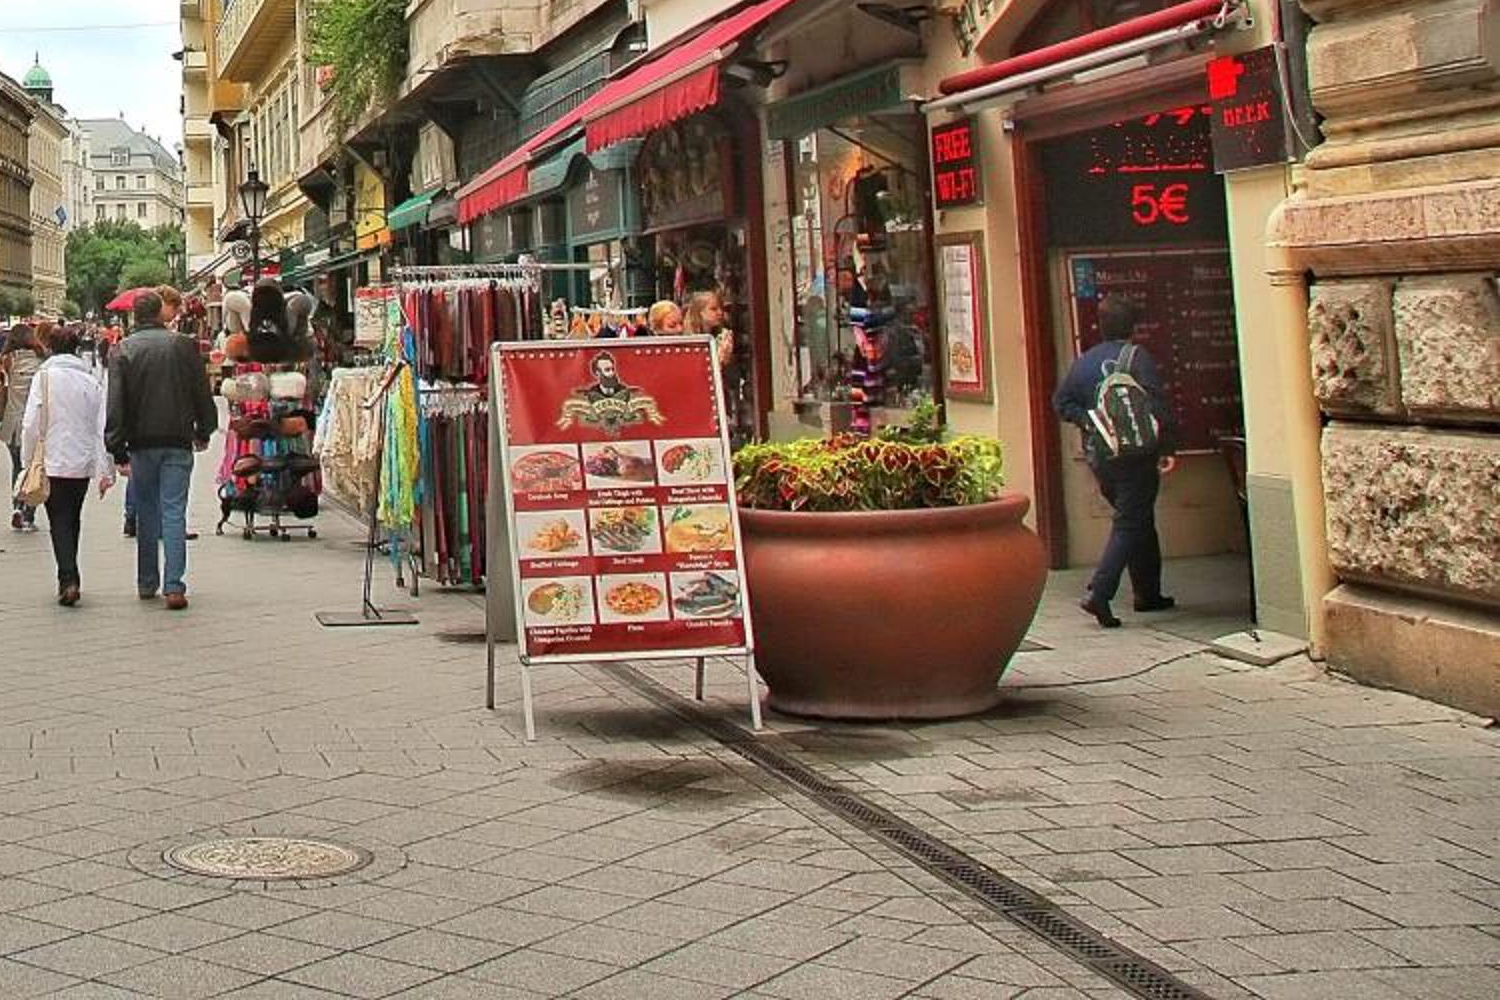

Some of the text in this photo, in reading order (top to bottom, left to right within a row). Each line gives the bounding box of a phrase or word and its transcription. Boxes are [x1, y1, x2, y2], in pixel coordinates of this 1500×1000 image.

[934, 127, 971, 162] FREE
[937, 168, 976, 200] WI-FI
[1131, 183, 1190, 225] 5€
